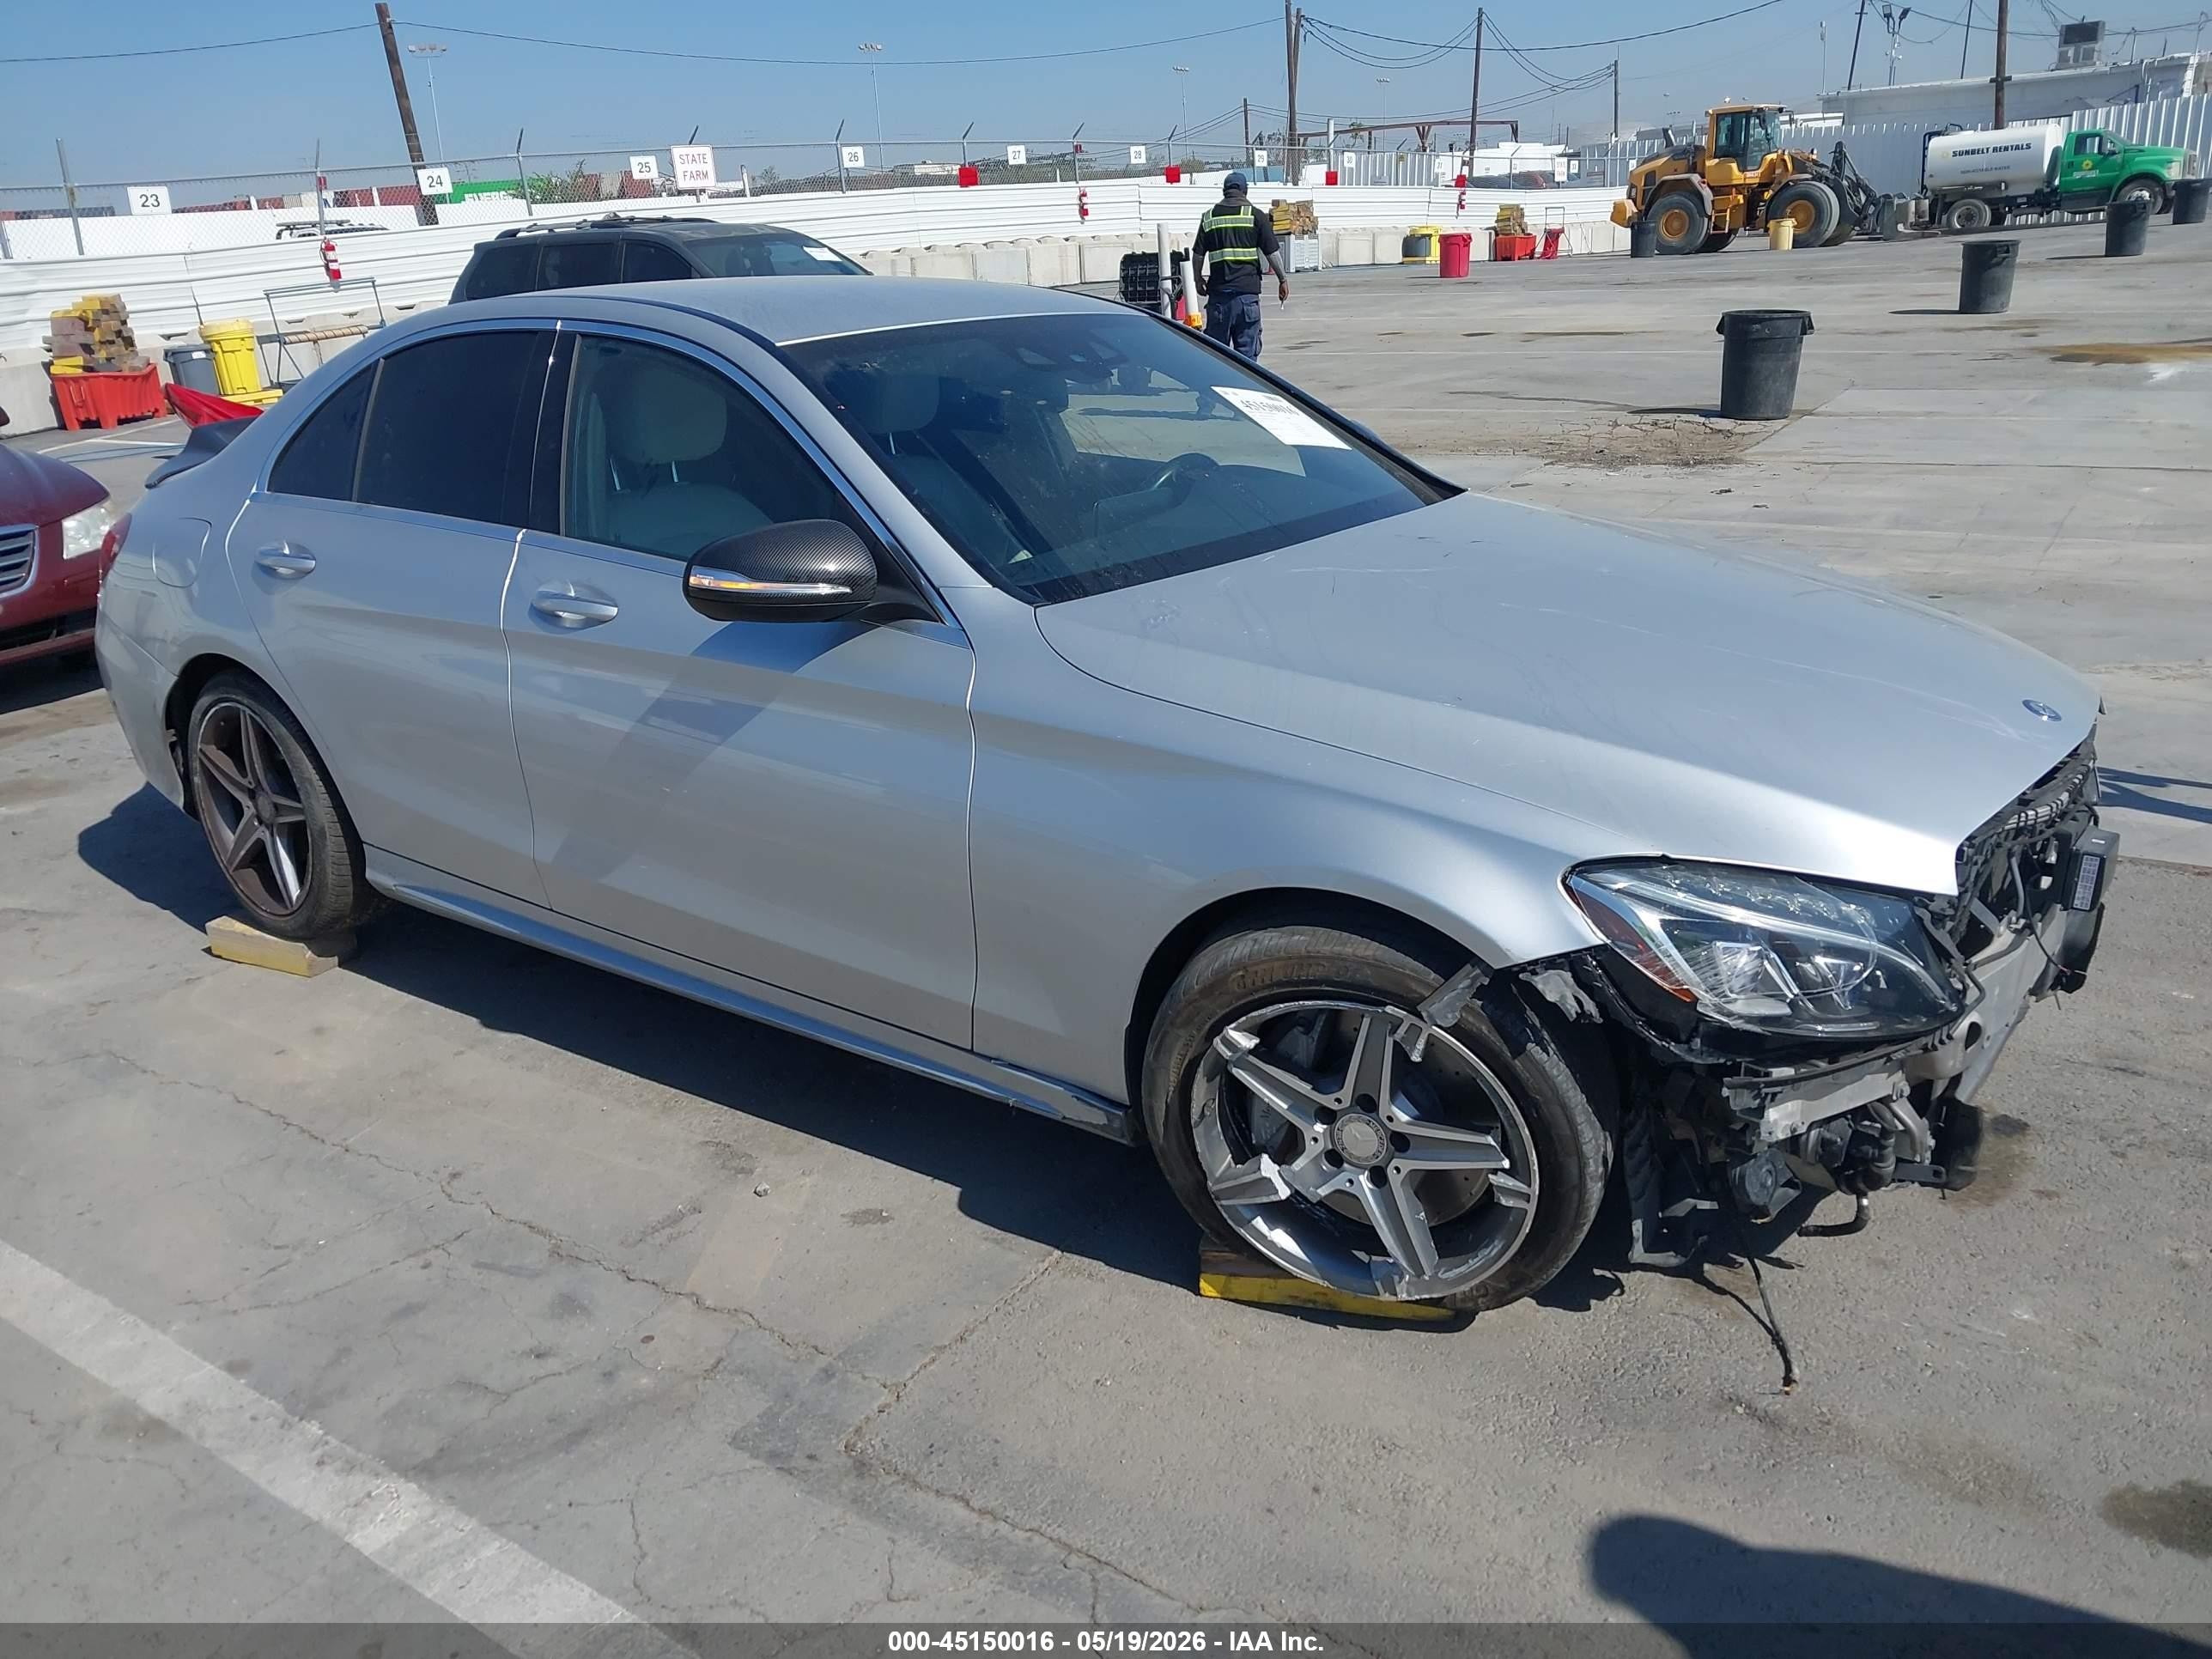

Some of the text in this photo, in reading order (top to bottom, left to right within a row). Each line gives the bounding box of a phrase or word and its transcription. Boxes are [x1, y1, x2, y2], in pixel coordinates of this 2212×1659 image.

[1012, 150, 1021, 160] 27
[1133, 149, 1142, 160] 28
[1952, 143, 2032, 158] SUNBELT RENTALS
[678, 153, 708, 165] STATE
[848, 151, 860, 162] 26
[1257, 154, 1265, 163] 29
[637, 161, 652, 173] 25
[683, 170, 708, 181] FARM
[427, 175, 443, 188] 24
[139, 193, 161, 208] 23
